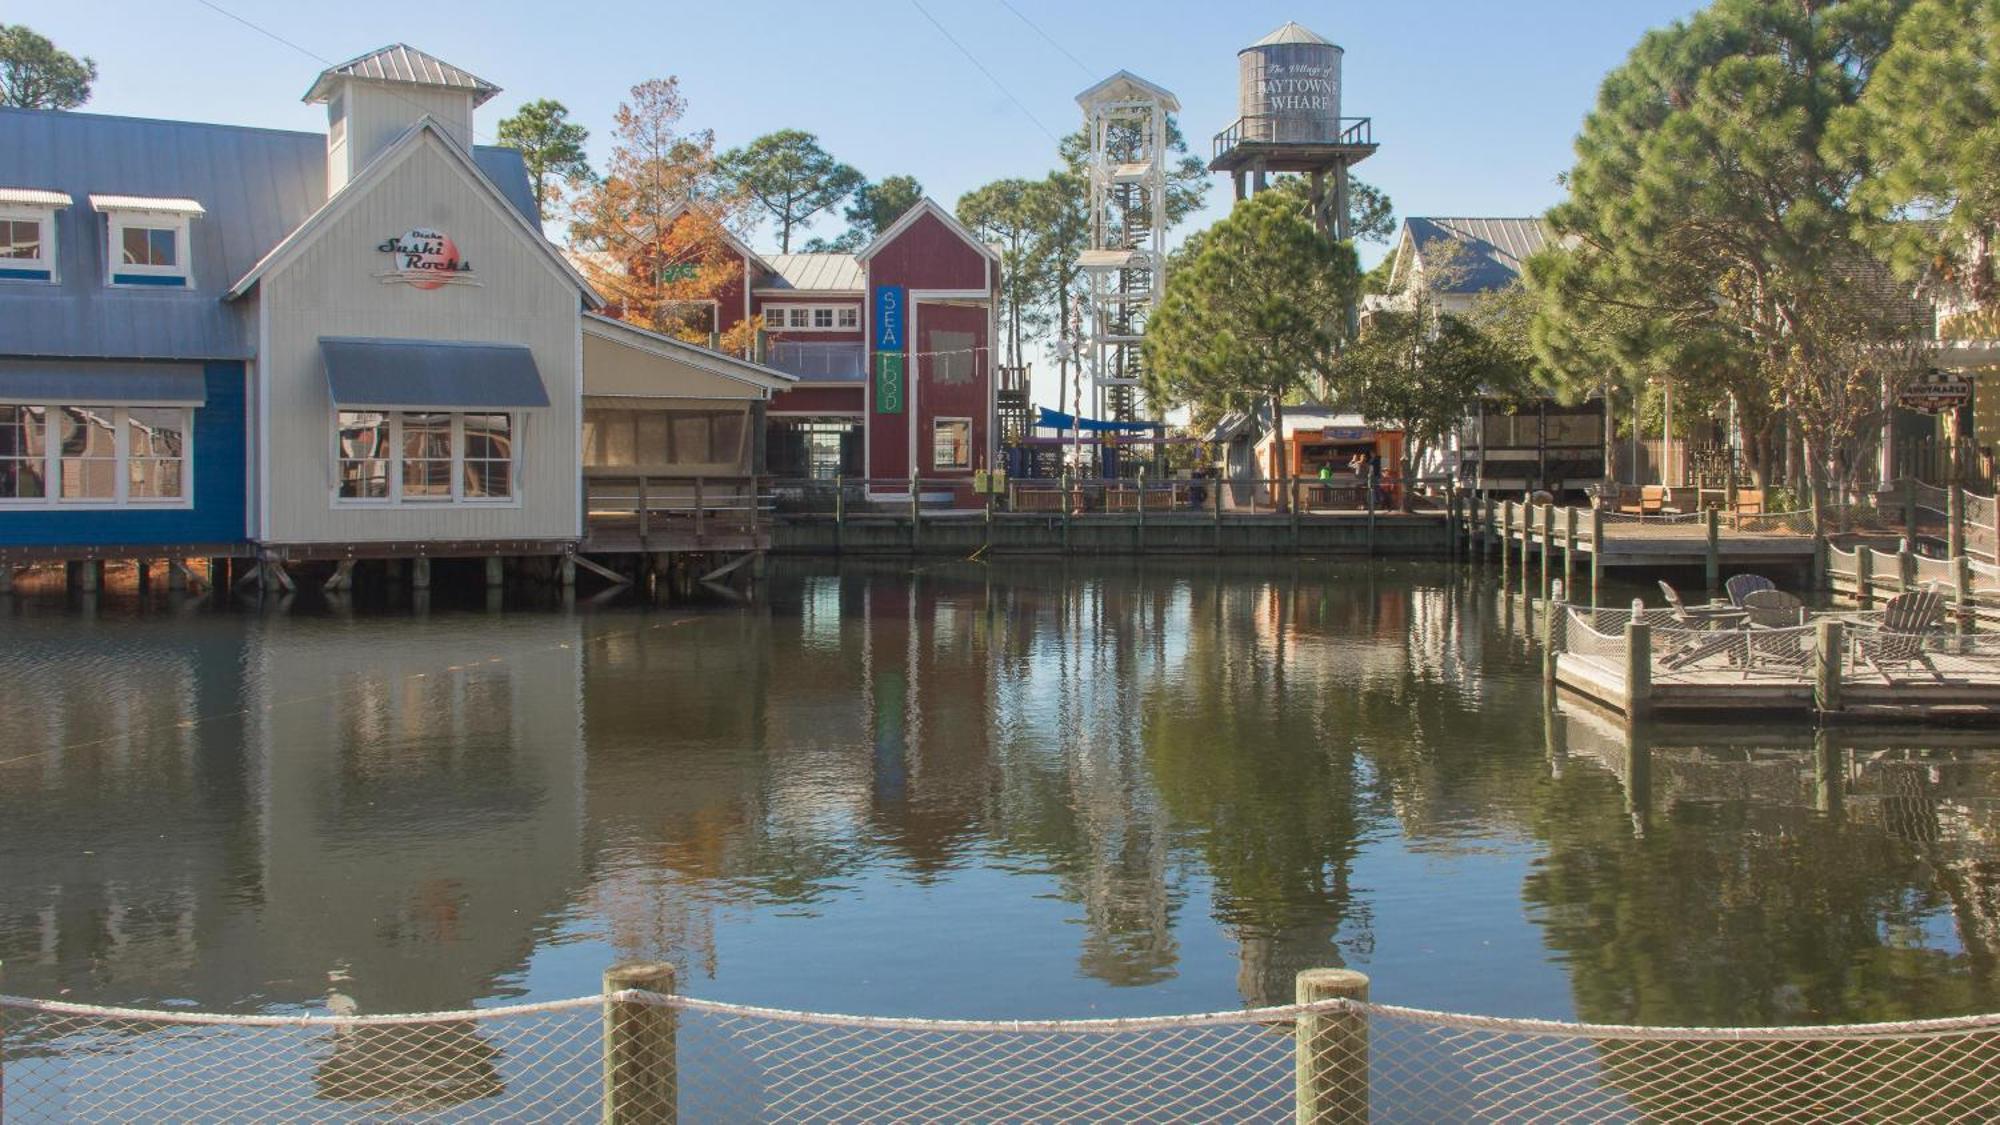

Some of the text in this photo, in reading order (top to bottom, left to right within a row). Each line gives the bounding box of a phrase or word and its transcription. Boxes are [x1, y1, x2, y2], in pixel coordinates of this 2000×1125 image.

[1269, 63, 1333, 78] The Village of
[1271, 96, 1328, 110] WHARF
[378, 238, 444, 255] Sushi
[405, 254, 474, 271] Rocks
